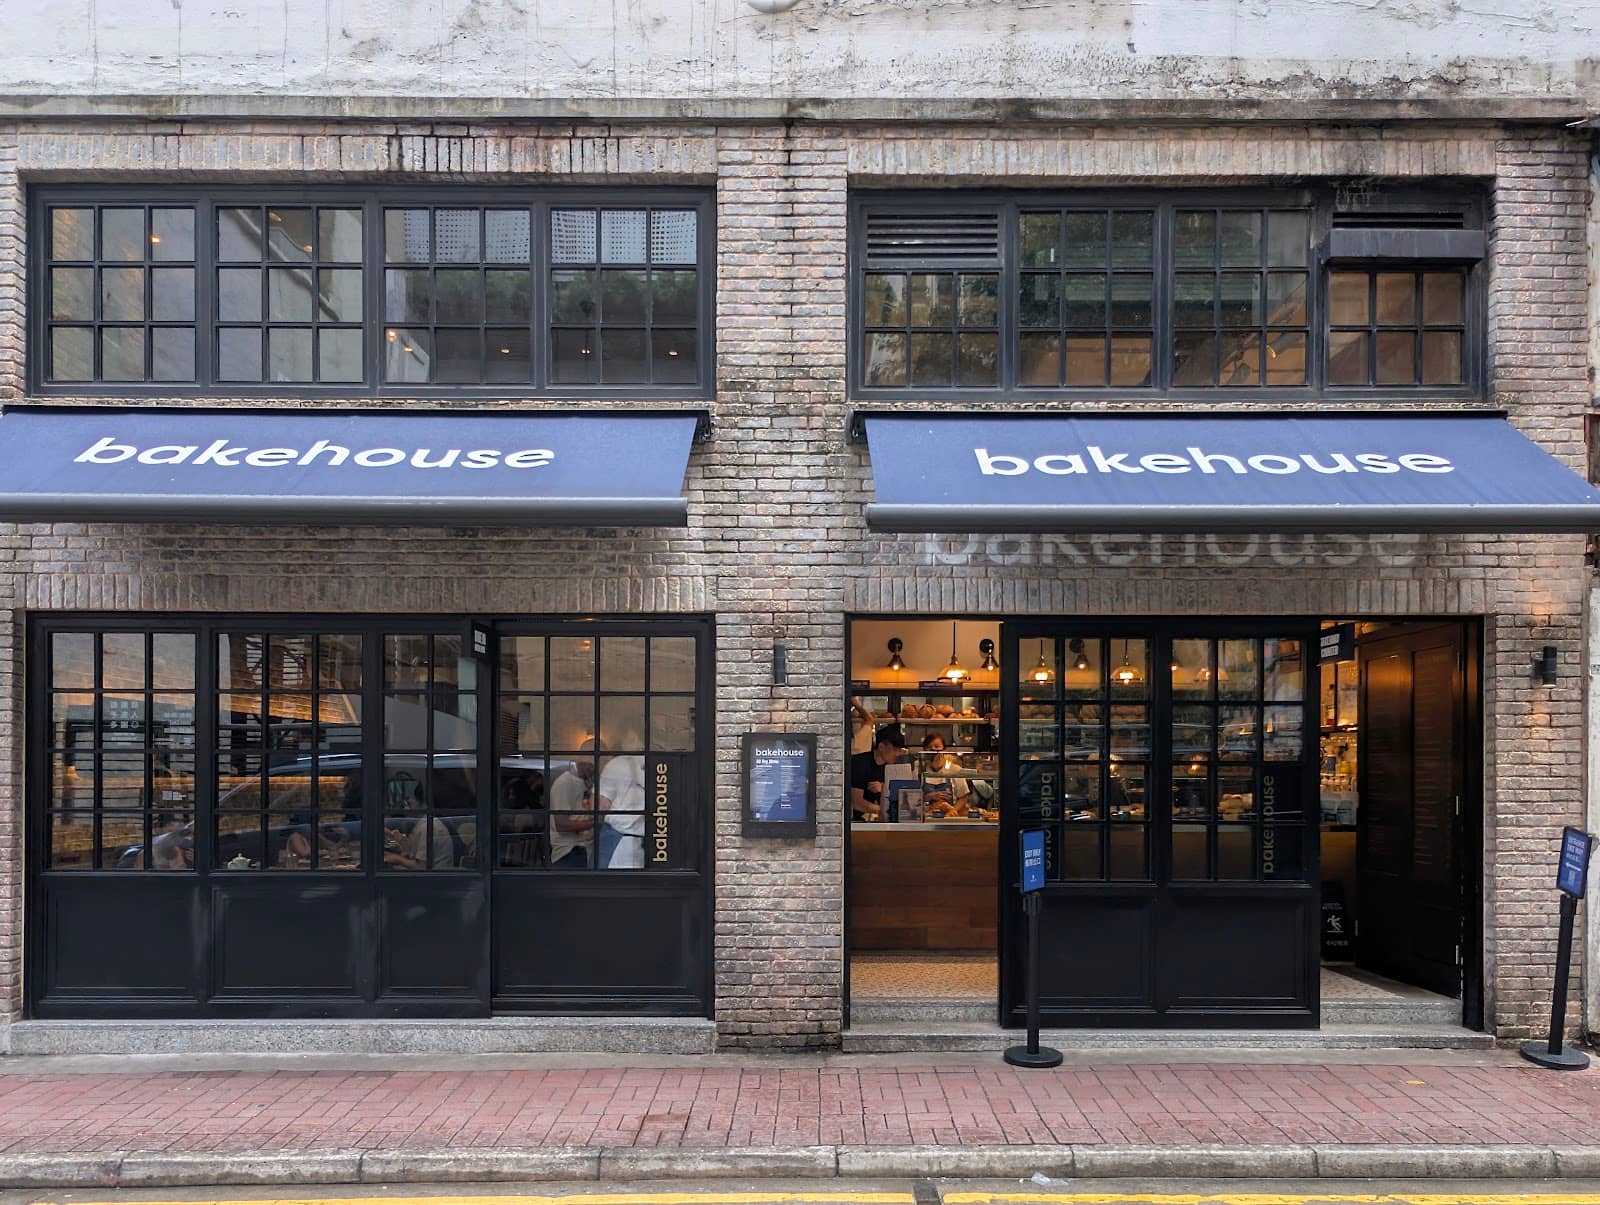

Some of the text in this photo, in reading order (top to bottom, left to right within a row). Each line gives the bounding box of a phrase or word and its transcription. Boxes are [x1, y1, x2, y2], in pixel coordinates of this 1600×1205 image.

[73, 437, 555, 469] bakehouse
[974, 446, 1455, 475] bakehouse
[755, 747, 804, 757] bakehouse
[652, 762, 668, 862] bakehouse
